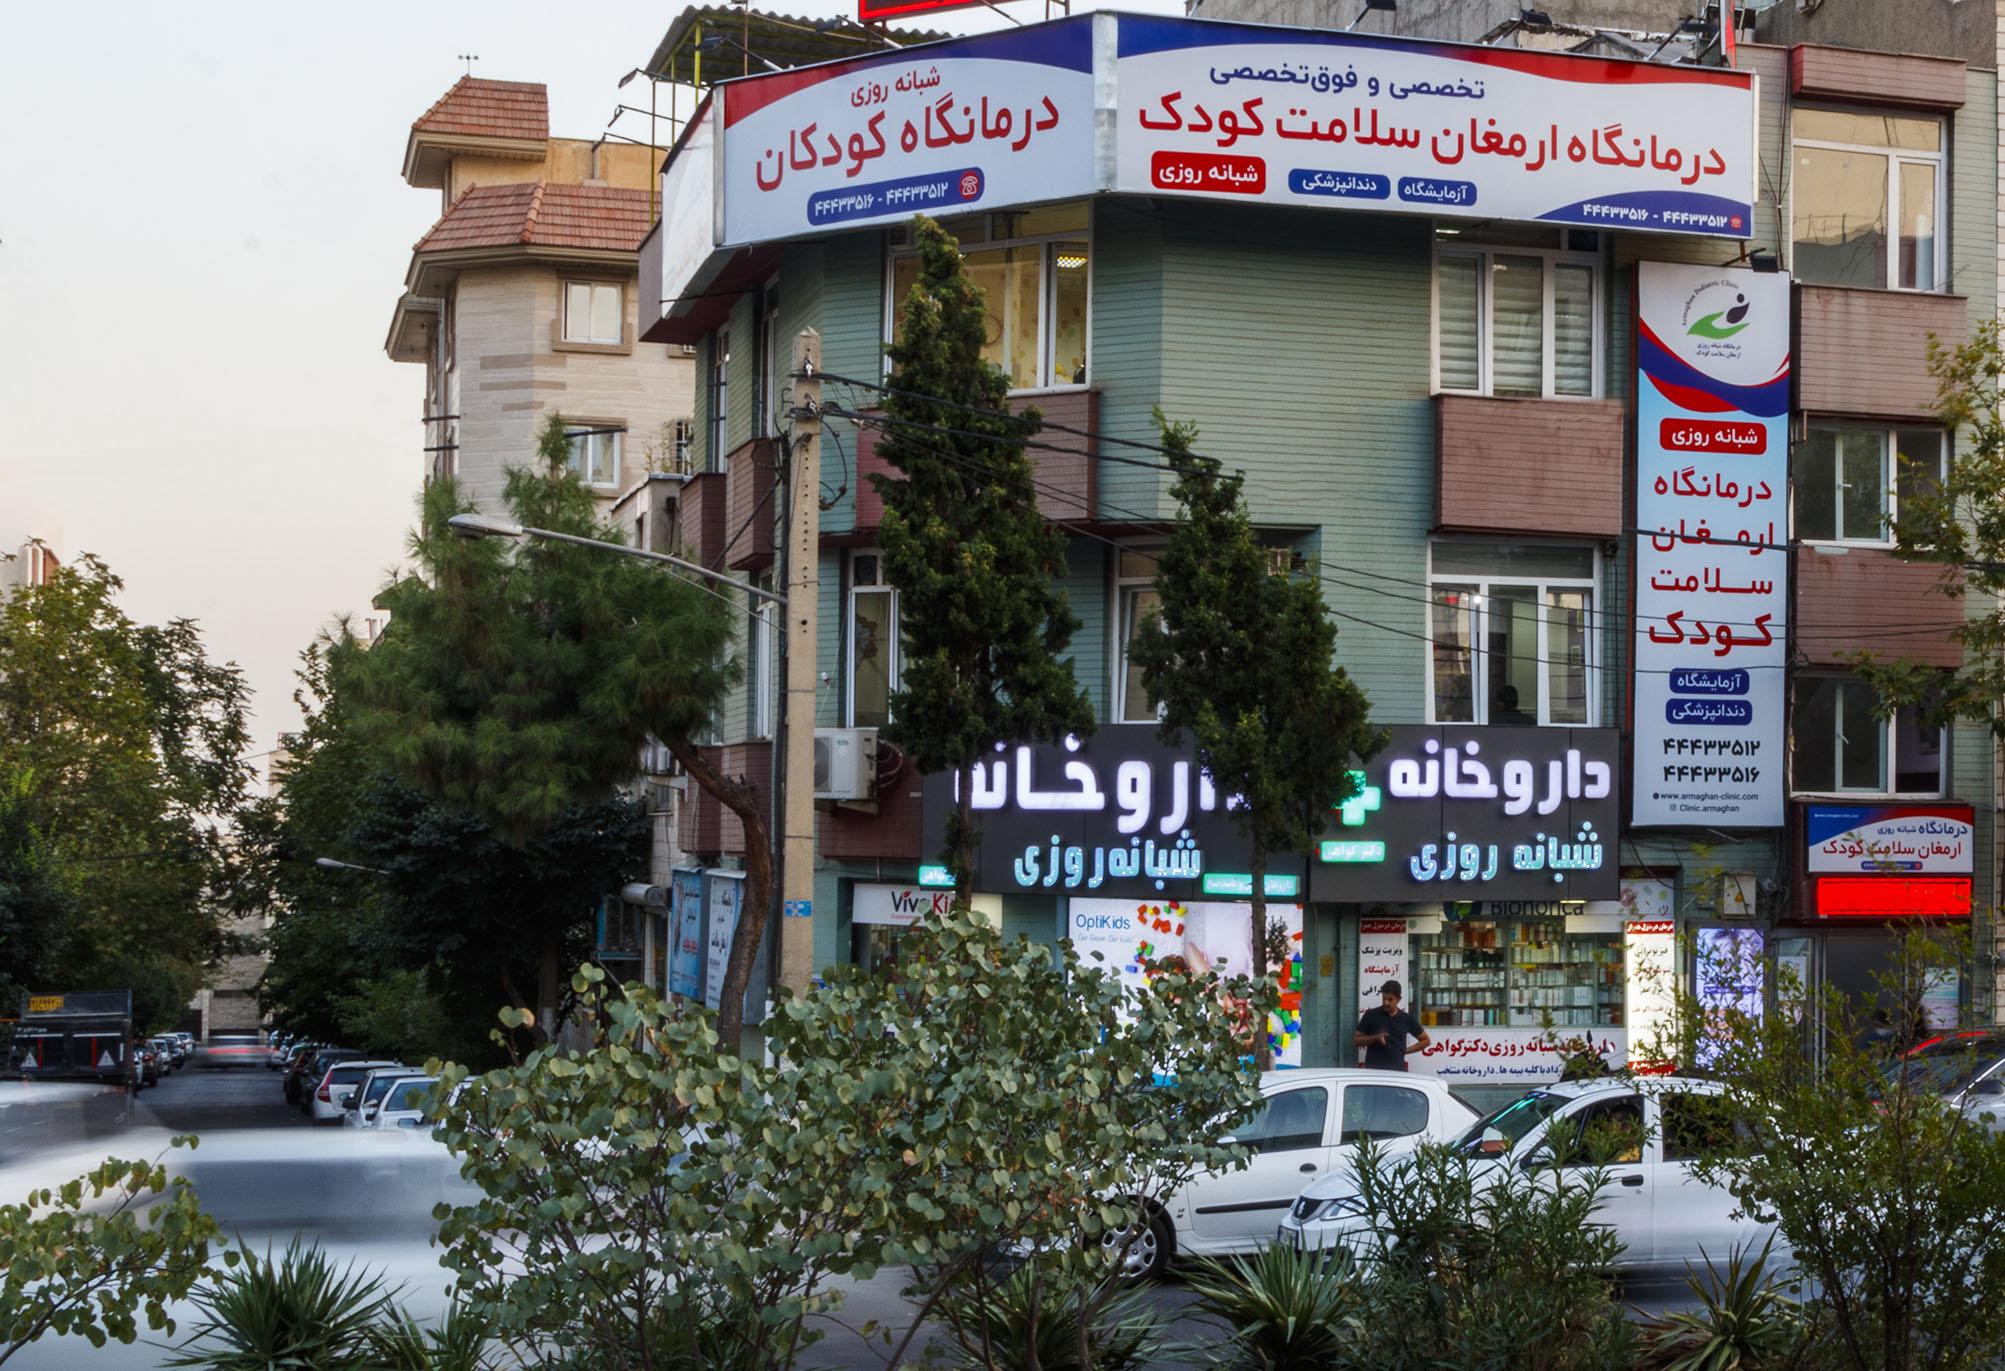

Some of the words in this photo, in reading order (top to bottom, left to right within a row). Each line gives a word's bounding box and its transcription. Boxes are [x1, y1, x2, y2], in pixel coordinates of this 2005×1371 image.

[895, 66, 940, 96] شبانه
[1368, 77, 1379, 97] و
[1389, 78, 1485, 99] تخصصی
[851, 83, 889, 107] روزی
[900, 92, 1060, 153] درمانگاه
[1139, 91, 1264, 147] کودک
[1276, 107, 1420, 149] سلامت
[756, 110, 886, 192] کودکان
[1431, 118, 1557, 171] ارمغان
[1567, 123, 1726, 185] درمانگاه
[1159, 163, 1201, 184] روزی
[1209, 164, 1258, 186] شبانه
[1302, 174, 1377, 194] دندانپزشکی
[886, 182, 948, 206] ۴۴۴۳۳۵۱۲
[1404, 181, 1468, 203] آزمایشگاه
[815, 195, 874, 217] ۴۴۴۳۳۵۱۶
[1583, 203, 1649, 221] ۴۴۴۳۳۵۱۶
[1663, 211, 1728, 228] ۴۴۴۳۳۵۱۲
[1672, 428, 1710, 446] روزی
[1715, 428, 1758, 448] شبانه
[1654, 466, 1772, 508] درمانگاه
[1652, 519, 1773, 555] ارمغان
[1651, 567, 1773, 595] سلامت
[1649, 610, 1772, 657] کودک
[1677, 673, 1741, 691] آزمایشگاه
[1672, 702, 1745, 721] دندانپزشکی
[1663, 738, 1760, 756] ۴۴۴۳۳۵۱۲
[1389, 739, 1611, 816] داروخانه
[1663, 765, 1760, 783] ۴۴۴۳۳۵۱۶
[1877, 826, 1895, 835] روزی
[1897, 825, 1917, 835] شبانه
[1919, 821, 1968, 838] درمانگاه
[1109, 829, 1201, 890] شبانه
[1410, 831, 1499, 882] روزی
[1513, 821, 1603, 883] شبانه
[1823, 840, 1864, 858] کودک
[1918, 841, 1961, 859] ارمغان
[1014, 834, 1104, 889] روزی
[1076, 914, 1131, 931] OptiKids
